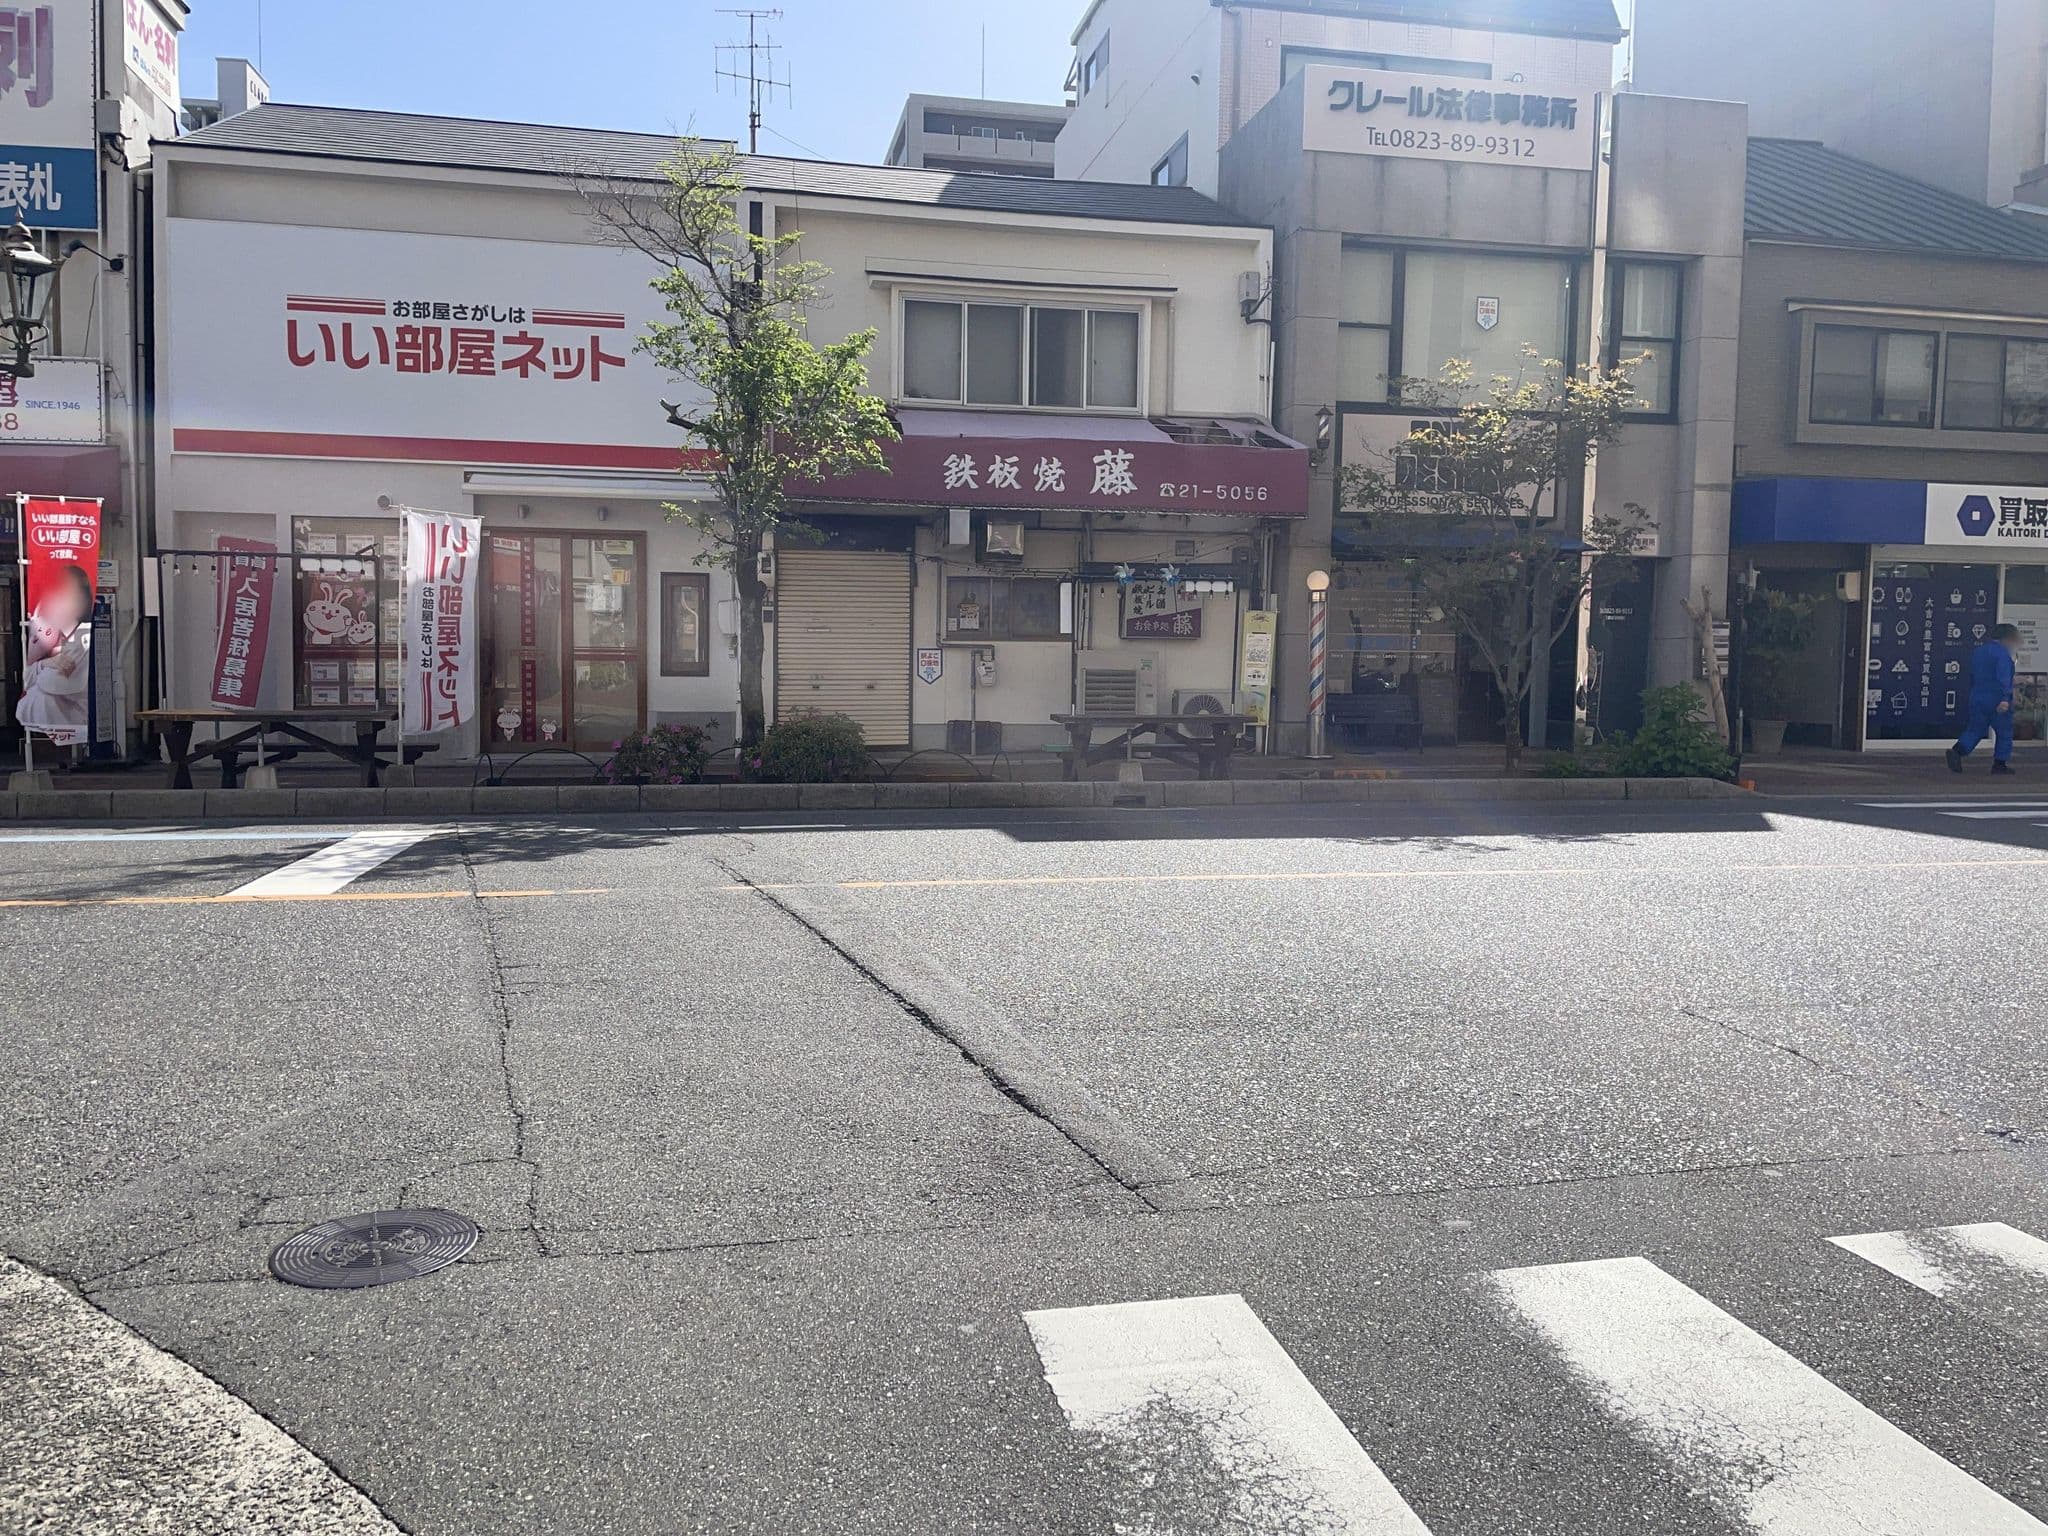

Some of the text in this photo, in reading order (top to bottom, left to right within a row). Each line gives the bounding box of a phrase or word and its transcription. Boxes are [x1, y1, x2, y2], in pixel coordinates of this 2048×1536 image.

[1328, 80, 1577, 130] クレール法律事務所
[0, 161, 62, 211] 表札
[391, 299, 526, 325] お部屋さがしは
[286, 318, 626, 382] いい部屋ネット
[942, 448, 1139, 497] 鉄板焼 藤
[1372, 494, 1461, 510] PROFESSIONA
[1998, 495, 2048, 528] 買取
[37, 528, 82, 545] いい部屋
[1997, 527, 2041, 539] KAITORI
[1172, 613, 1194, 636] 藤
